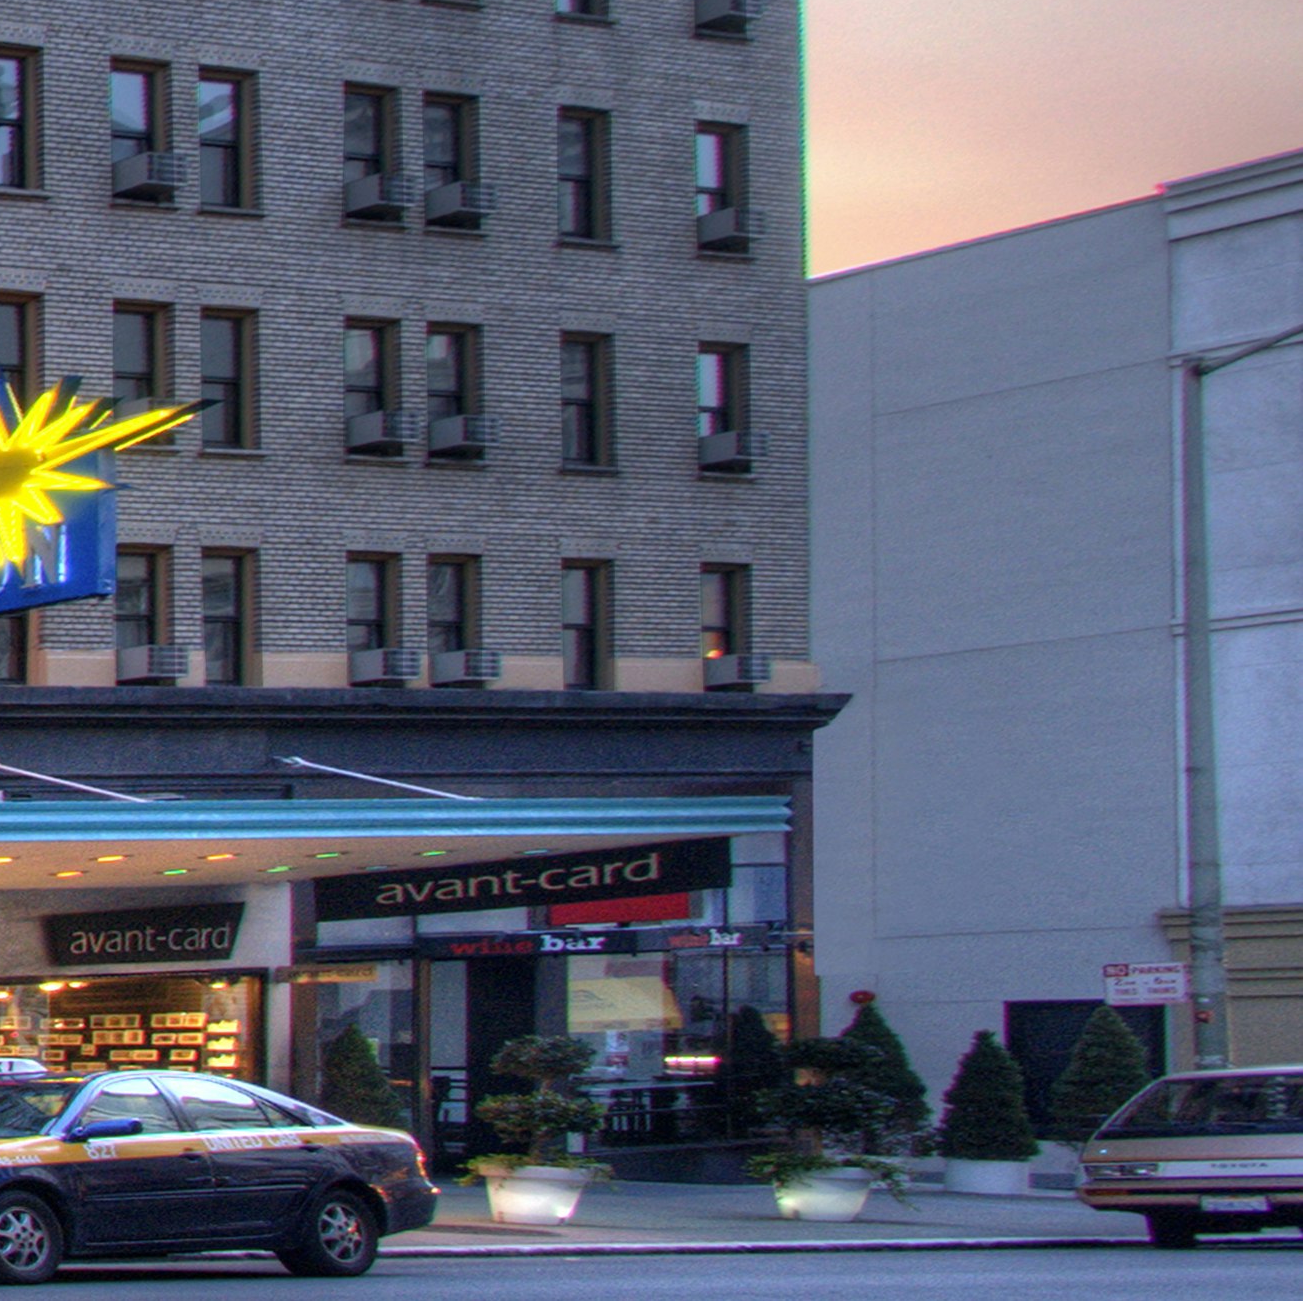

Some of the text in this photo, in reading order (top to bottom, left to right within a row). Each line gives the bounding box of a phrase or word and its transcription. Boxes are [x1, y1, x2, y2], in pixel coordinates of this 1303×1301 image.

[376, 852, 660, 905] avant-card
[70, 922, 230, 955] avant-card
[540, 934, 606, 951] bar
[709, 929, 742, 946] bar
[203, 1133, 302, 1151] UNITED CAB
